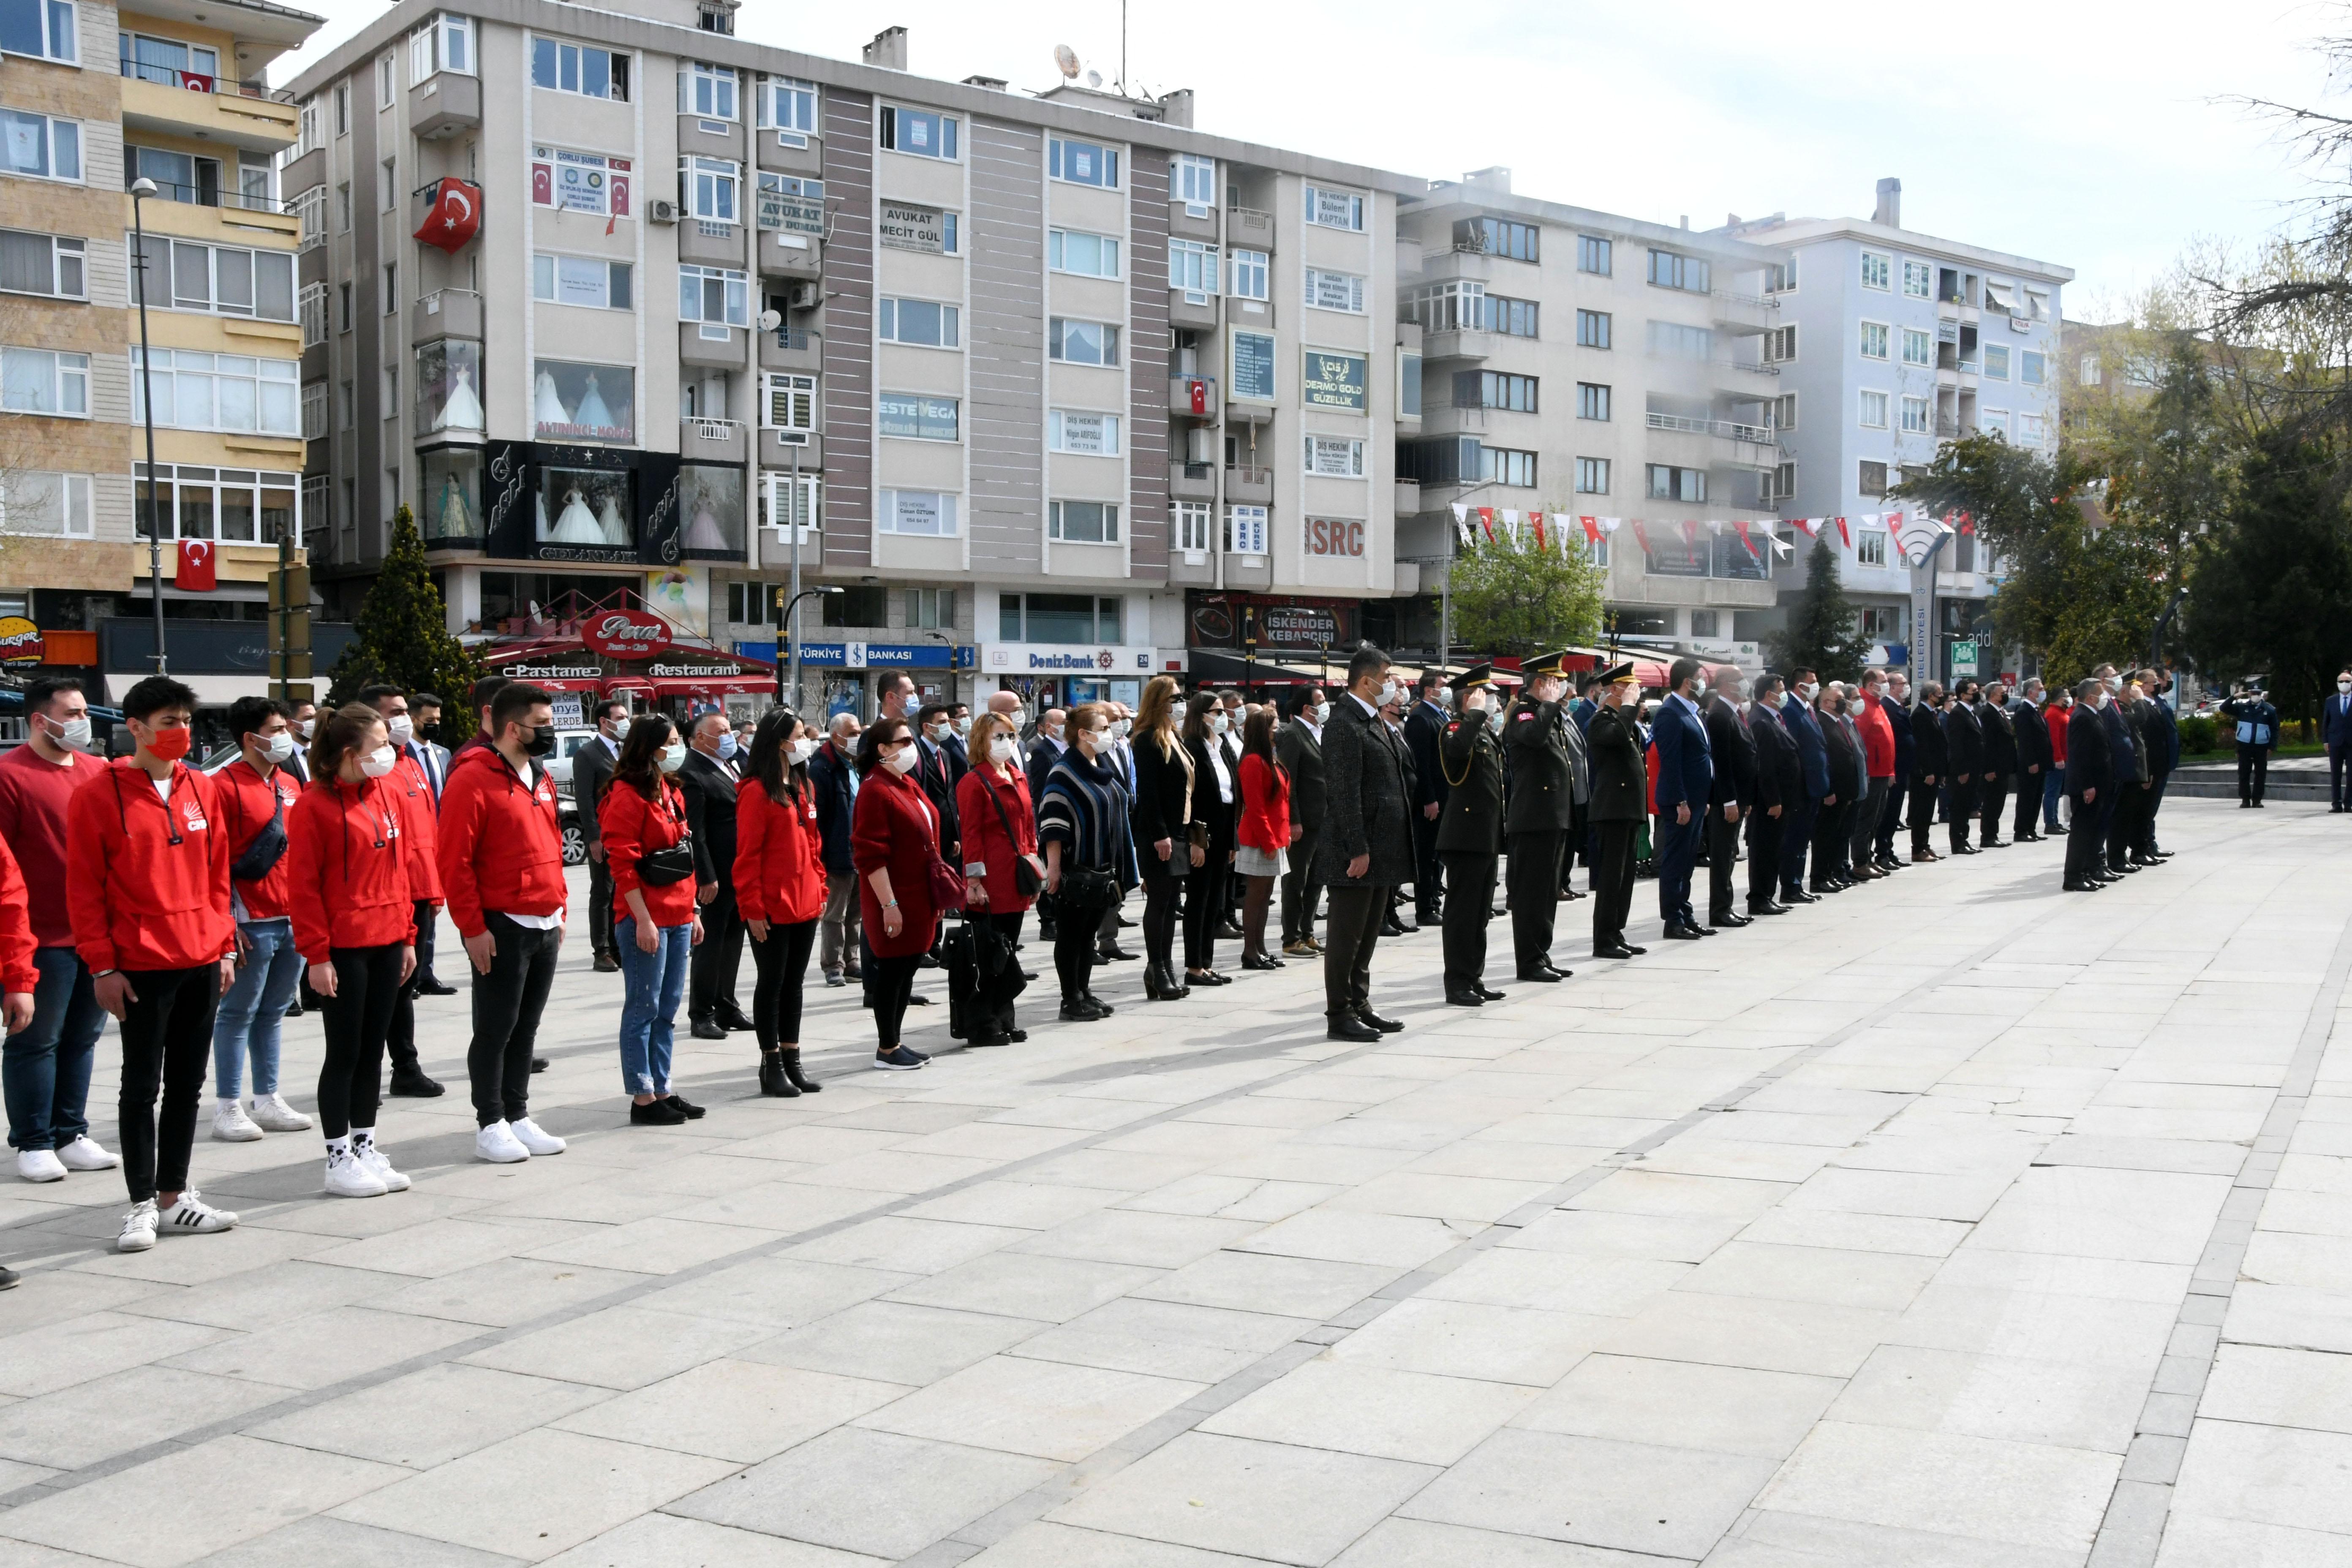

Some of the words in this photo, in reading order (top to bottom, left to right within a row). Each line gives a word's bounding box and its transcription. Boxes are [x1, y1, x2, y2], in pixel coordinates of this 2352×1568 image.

[558, 152, 579, 161] ÇORLU
[581, 157, 604, 166] ŞUBESİ
[762, 202, 821, 221] AVUKAT
[1322, 201, 1345, 213] Bülent
[887, 210, 932, 224] AVUKAT
[1318, 212, 1348, 226] KAPTAN
[880, 224, 914, 238] MECİT
[917, 230, 940, 242] GÜL
[1306, 380, 1337, 392] DERMO
[1339, 384, 1362, 395] GOLD
[1313, 392, 1352, 406] GÜZELLİK
[1067, 416, 1078, 425] DİŞ
[1079, 417, 1100, 426] HEKİMİ
[1318, 440, 1327, 452] DİŞ
[1311, 520, 1364, 556] SRC
[596, 616, 662, 640] Pera
[1268, 615, 1334, 629] İSKENDER
[1968, 629, 1991, 647] add
[799, 648, 841, 659] TÜRKİYE
[868, 651, 912, 660] BANKASI
[1029, 653, 1094, 669] DenizBank
[517, 664, 591, 677] Pastane
[654, 664, 739, 676] Restaurant
[563, 692, 578, 701] Özel
[551, 703, 580, 714] anya
[553, 717, 581, 726] LERDE
